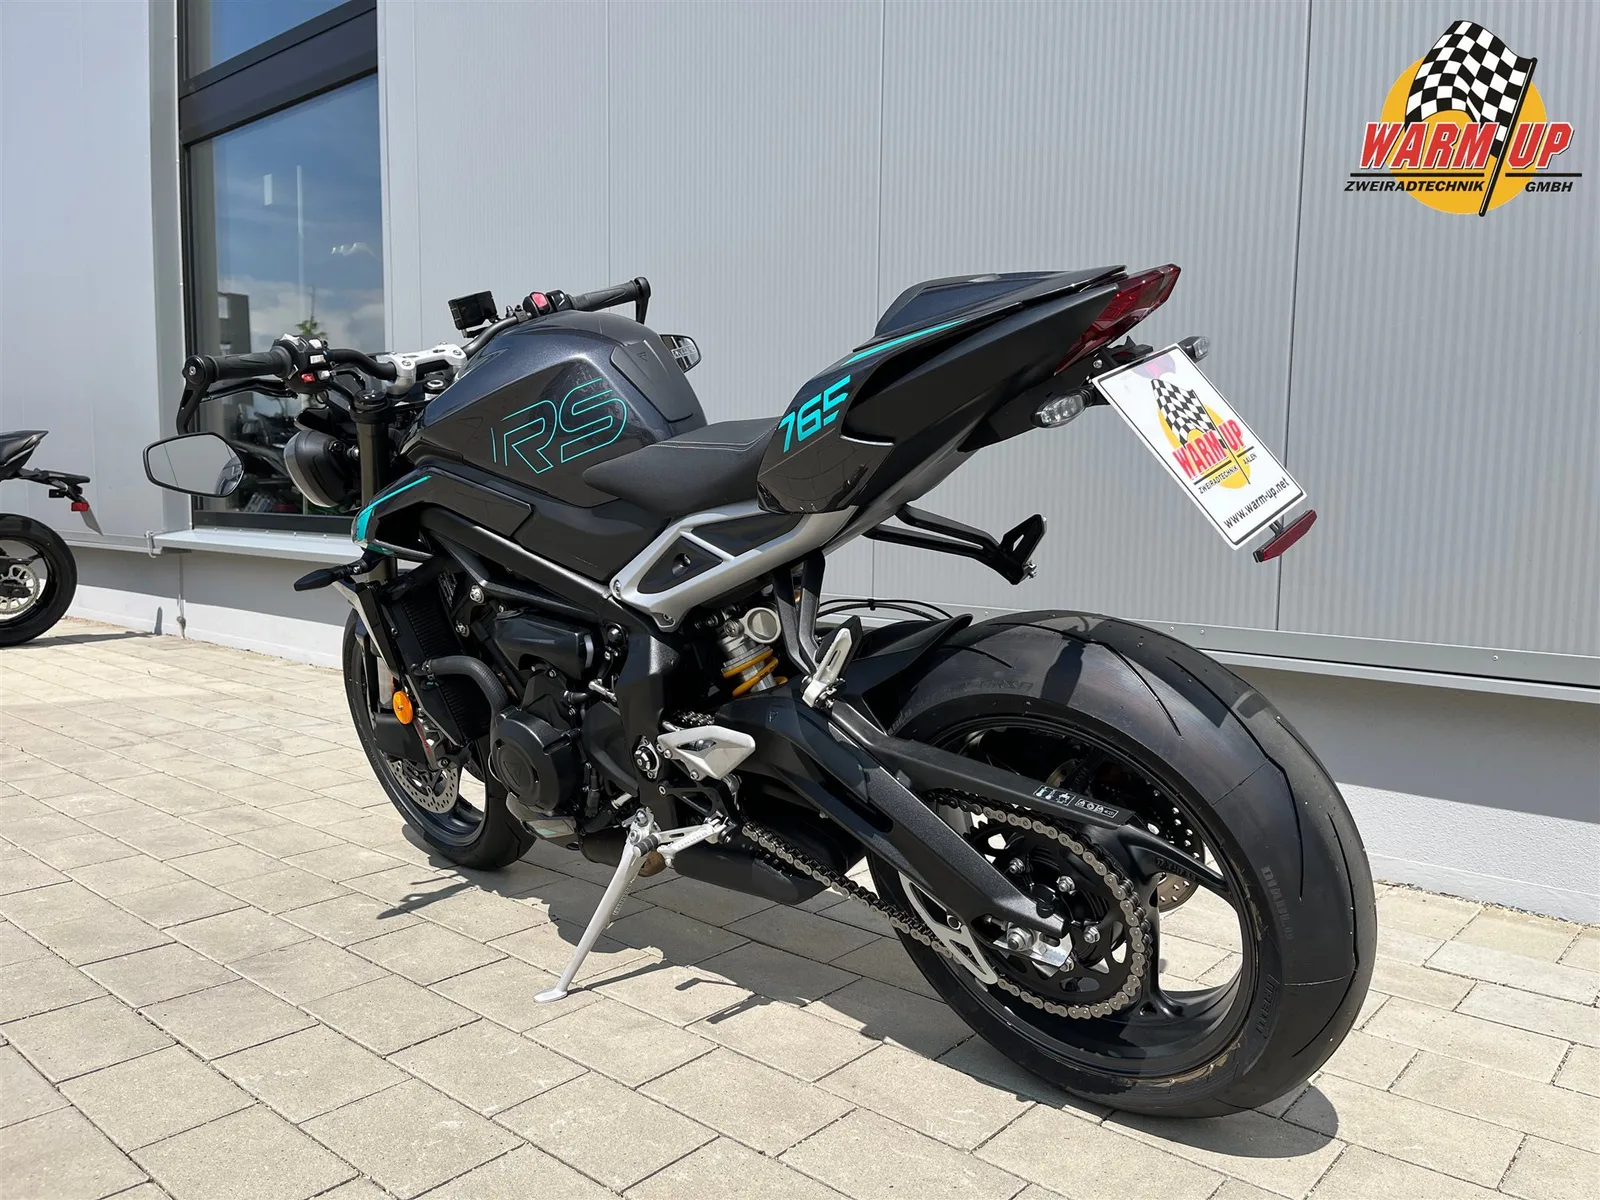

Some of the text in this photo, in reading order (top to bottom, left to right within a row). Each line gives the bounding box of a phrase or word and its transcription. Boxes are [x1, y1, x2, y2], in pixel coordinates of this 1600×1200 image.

[491, 377, 628, 474] RS
[778, 374, 851, 453] 765
[1172, 419, 1245, 480] WARM UP
[1198, 453, 1258, 494] ZWEIRADTECHNIK AALEN
[1223, 476, 1290, 529] www.warm-up.net
